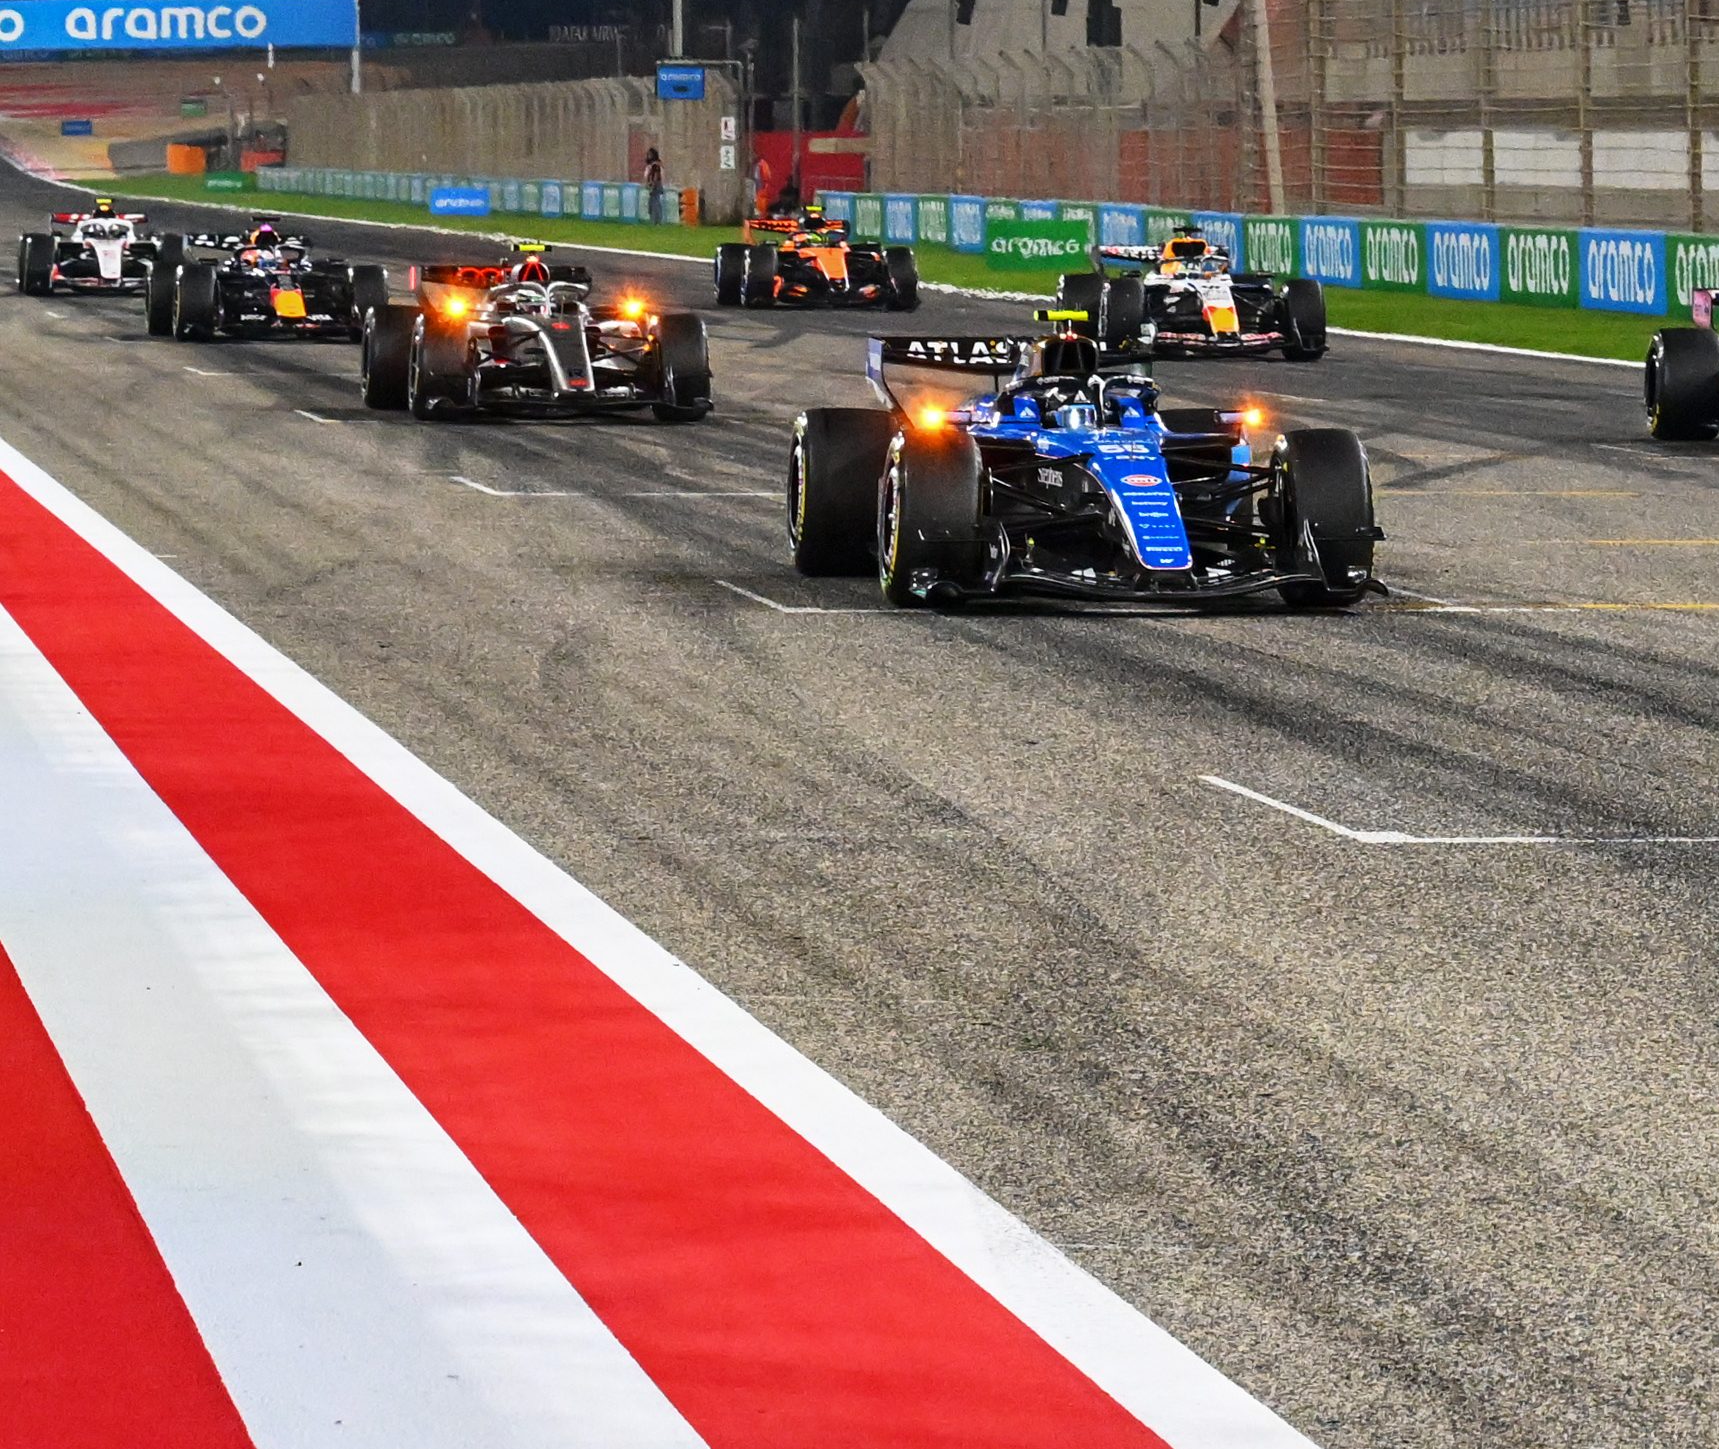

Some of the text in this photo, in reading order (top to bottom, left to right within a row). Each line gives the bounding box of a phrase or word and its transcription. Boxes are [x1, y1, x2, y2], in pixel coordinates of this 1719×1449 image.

[66, 6, 266, 40] aramco
[1306, 226, 1352, 279] aramco
[1367, 227, 1418, 284] aramco
[1434, 232, 1489, 290] aramco
[1508, 234, 1569, 294] aramco
[1588, 240, 1654, 304] aramco
